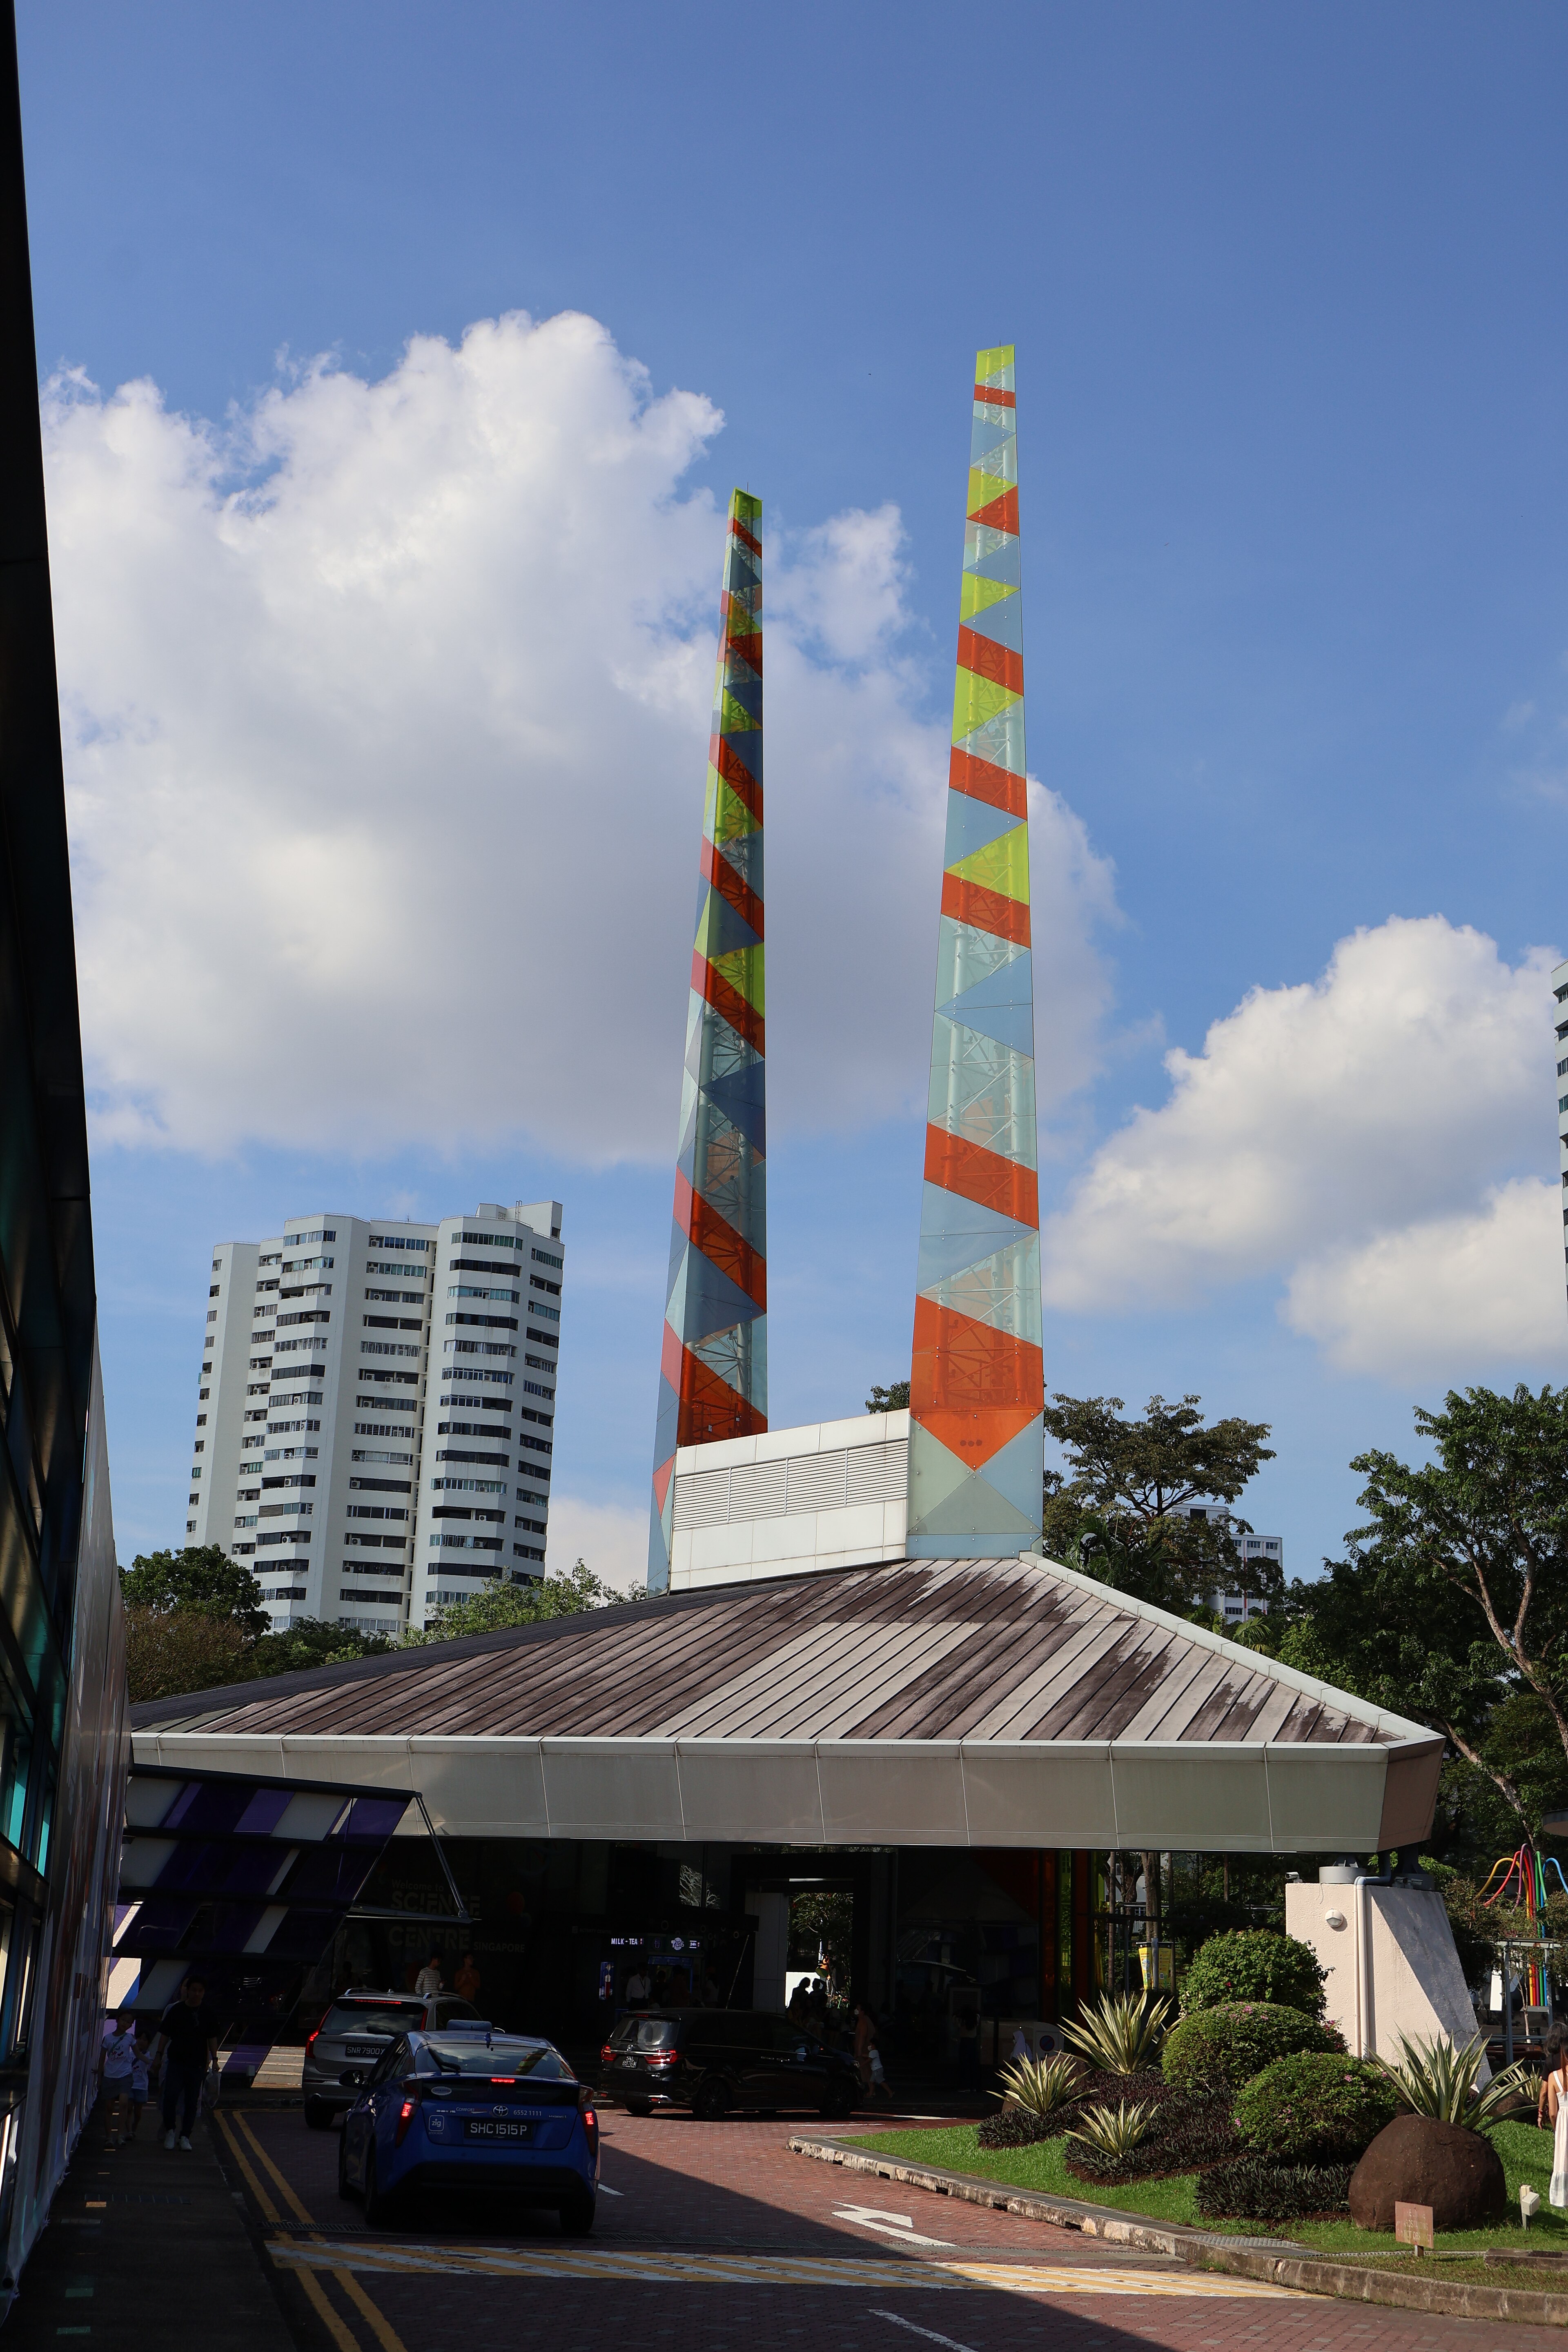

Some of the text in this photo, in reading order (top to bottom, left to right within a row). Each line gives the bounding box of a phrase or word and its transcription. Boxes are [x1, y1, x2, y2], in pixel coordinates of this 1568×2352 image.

[392, 1879, 444, 1892] Welcome to
[389, 1926, 470, 1950] CENTRE
[474, 1942, 525, 1953] SINGAPORE
[432, 2118, 441, 2127] zig
